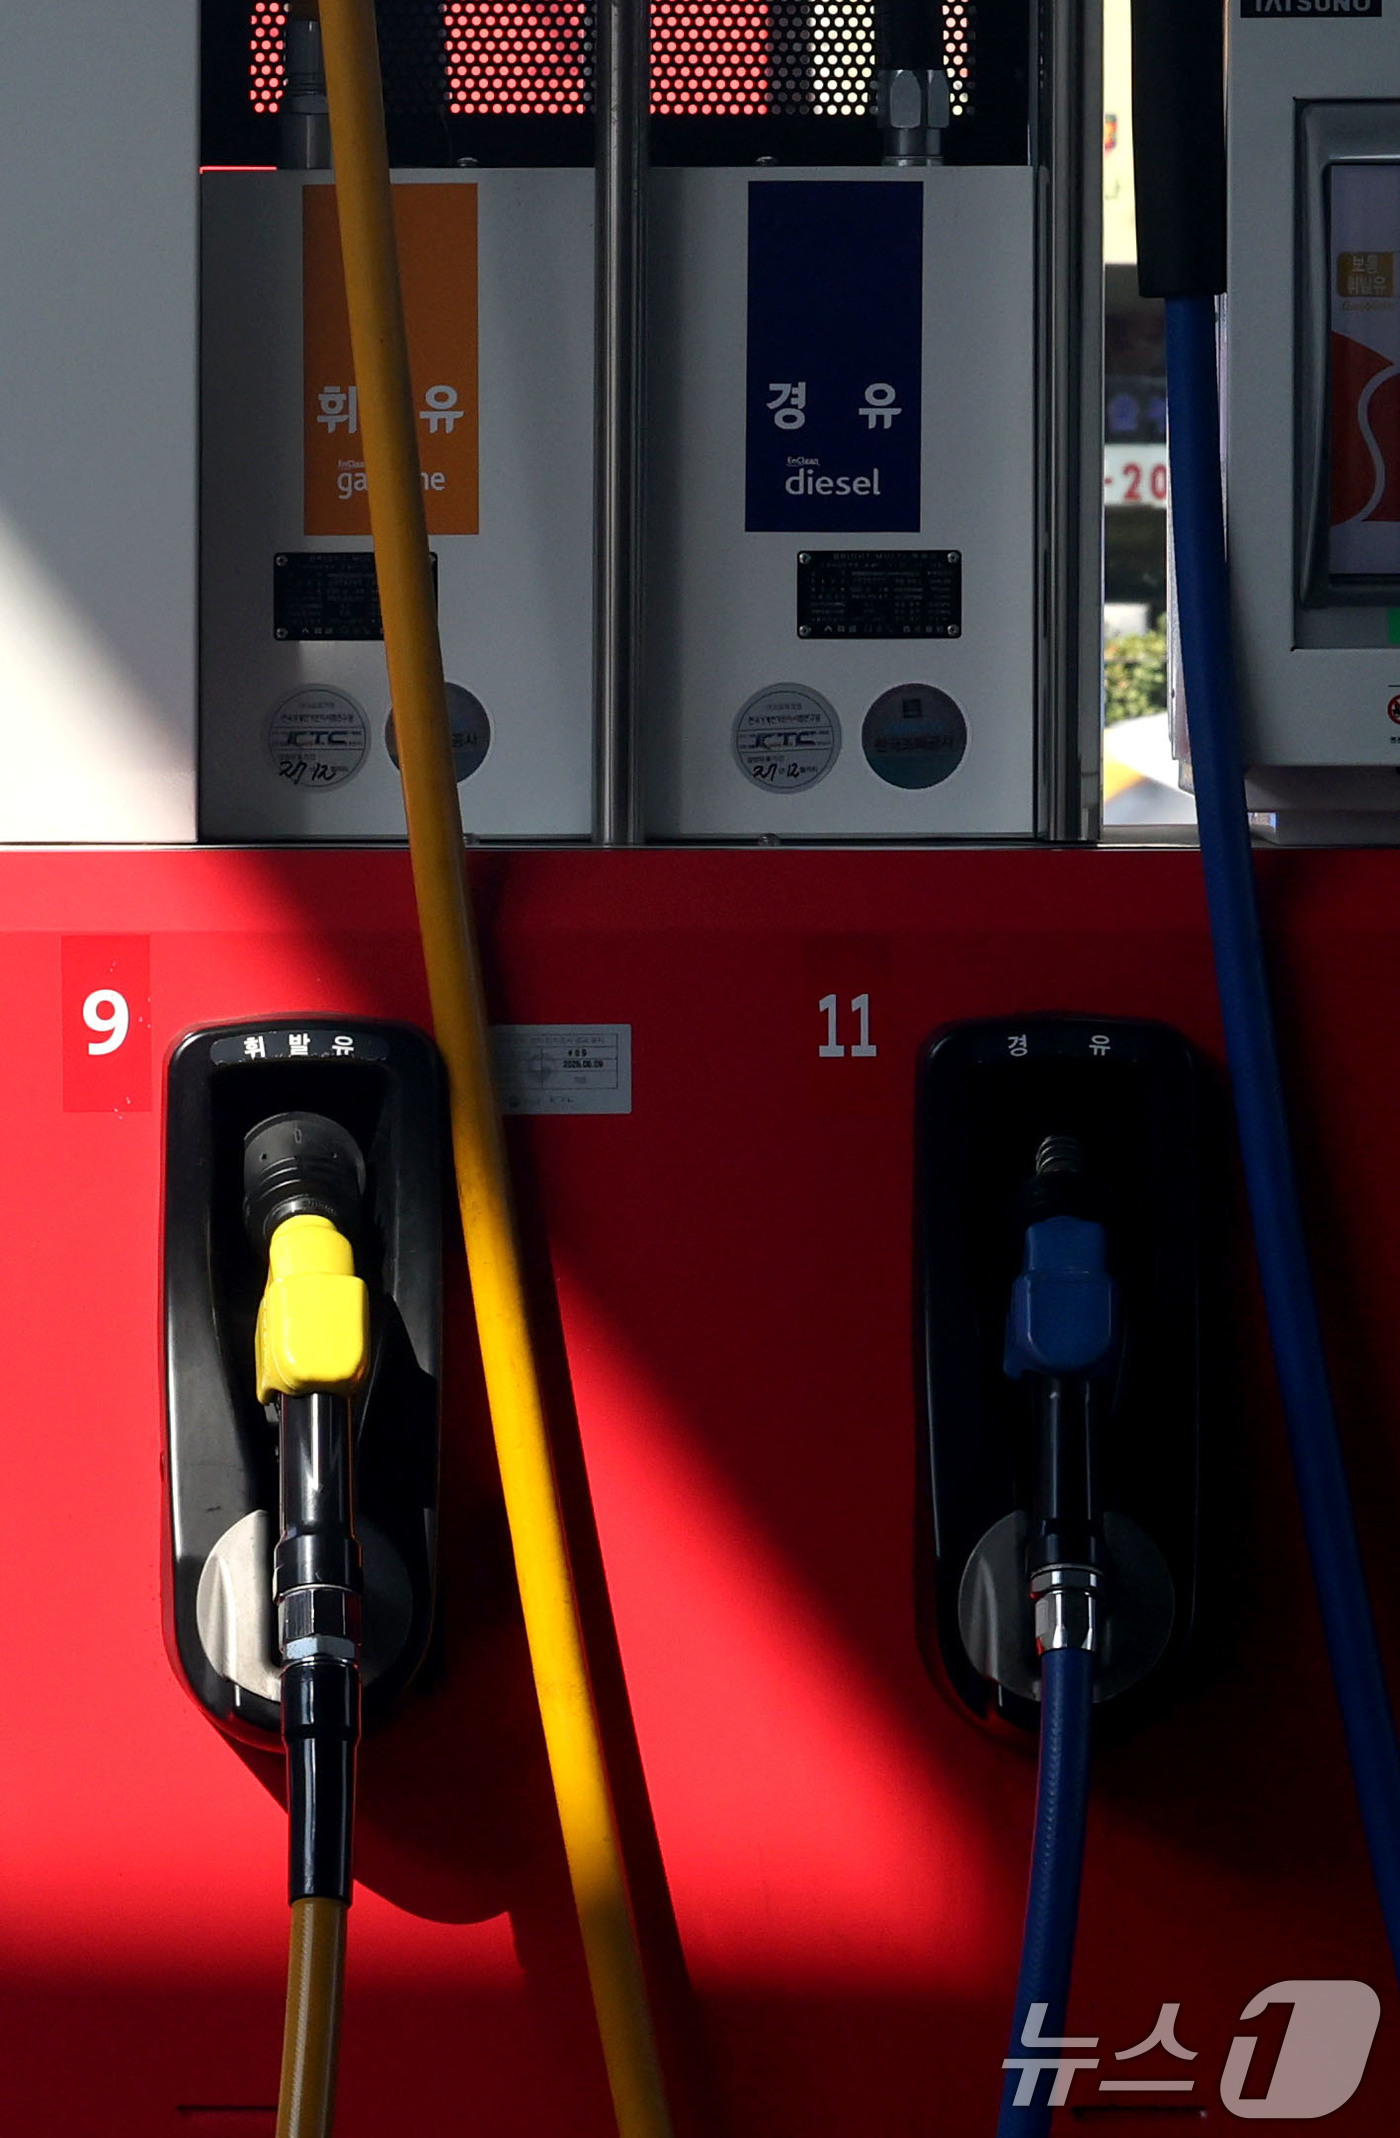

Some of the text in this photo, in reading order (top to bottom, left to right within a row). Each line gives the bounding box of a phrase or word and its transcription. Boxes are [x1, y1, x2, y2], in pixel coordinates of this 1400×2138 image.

[336, 470, 446, 499] gane
[785, 467, 881, 496] diesel
[313, 762, 336, 780] 12
[787, 762, 800, 778] 12
[82, 988, 130, 1056] 9
[818, 993, 878, 1058] 11
